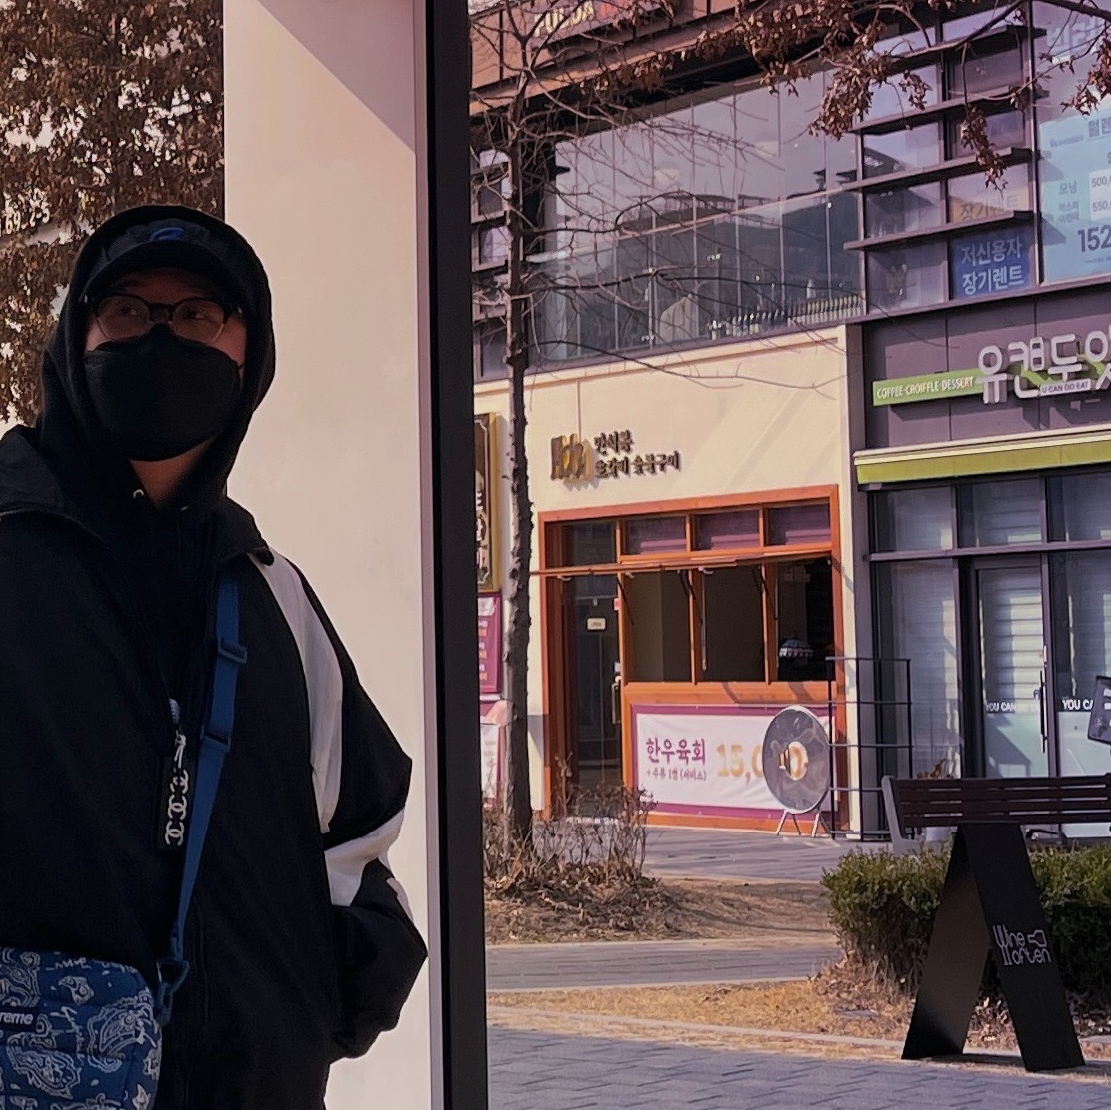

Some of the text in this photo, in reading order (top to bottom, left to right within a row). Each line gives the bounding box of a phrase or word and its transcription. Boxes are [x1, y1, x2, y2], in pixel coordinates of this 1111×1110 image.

[1091, 176, 1111, 188] 500,
[1092, 200, 1111, 212] 550,
[961, 236, 1022, 267] 저신용자
[962, 265, 1024, 295] 장기렌트
[1048, 385, 1063, 393] CAN
[1065, 383, 1075, 391] DO
[985, 702, 1000, 712] YOU
[1062, 699, 1081, 710] YOU
[646, 737, 705, 766] 한우육회
